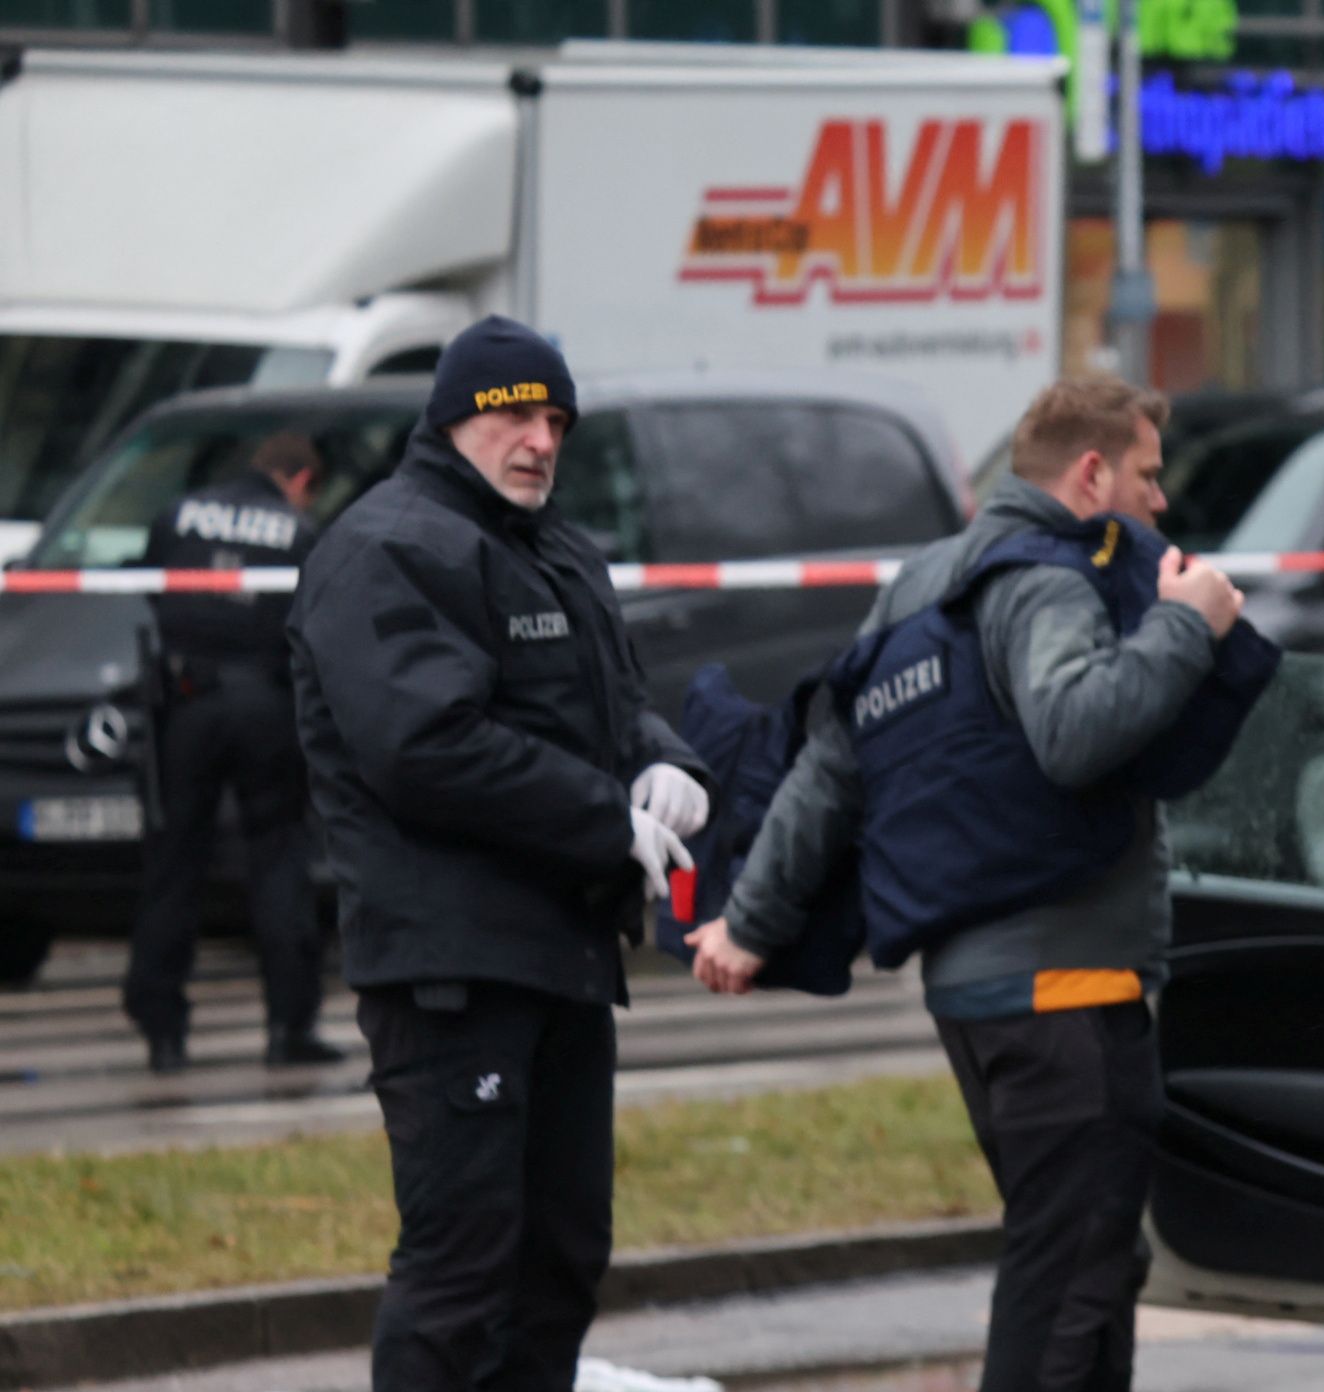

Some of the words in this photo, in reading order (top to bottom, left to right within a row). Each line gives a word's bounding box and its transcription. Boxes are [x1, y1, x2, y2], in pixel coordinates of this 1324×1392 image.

[775, 117, 1035, 283] AVM
[475, 382, 548, 411] POLIZEI
[176, 500, 296, 550] POLIZEI
[509, 612, 569, 639] POLIZEI
[855, 656, 941, 727] POLIZEI
